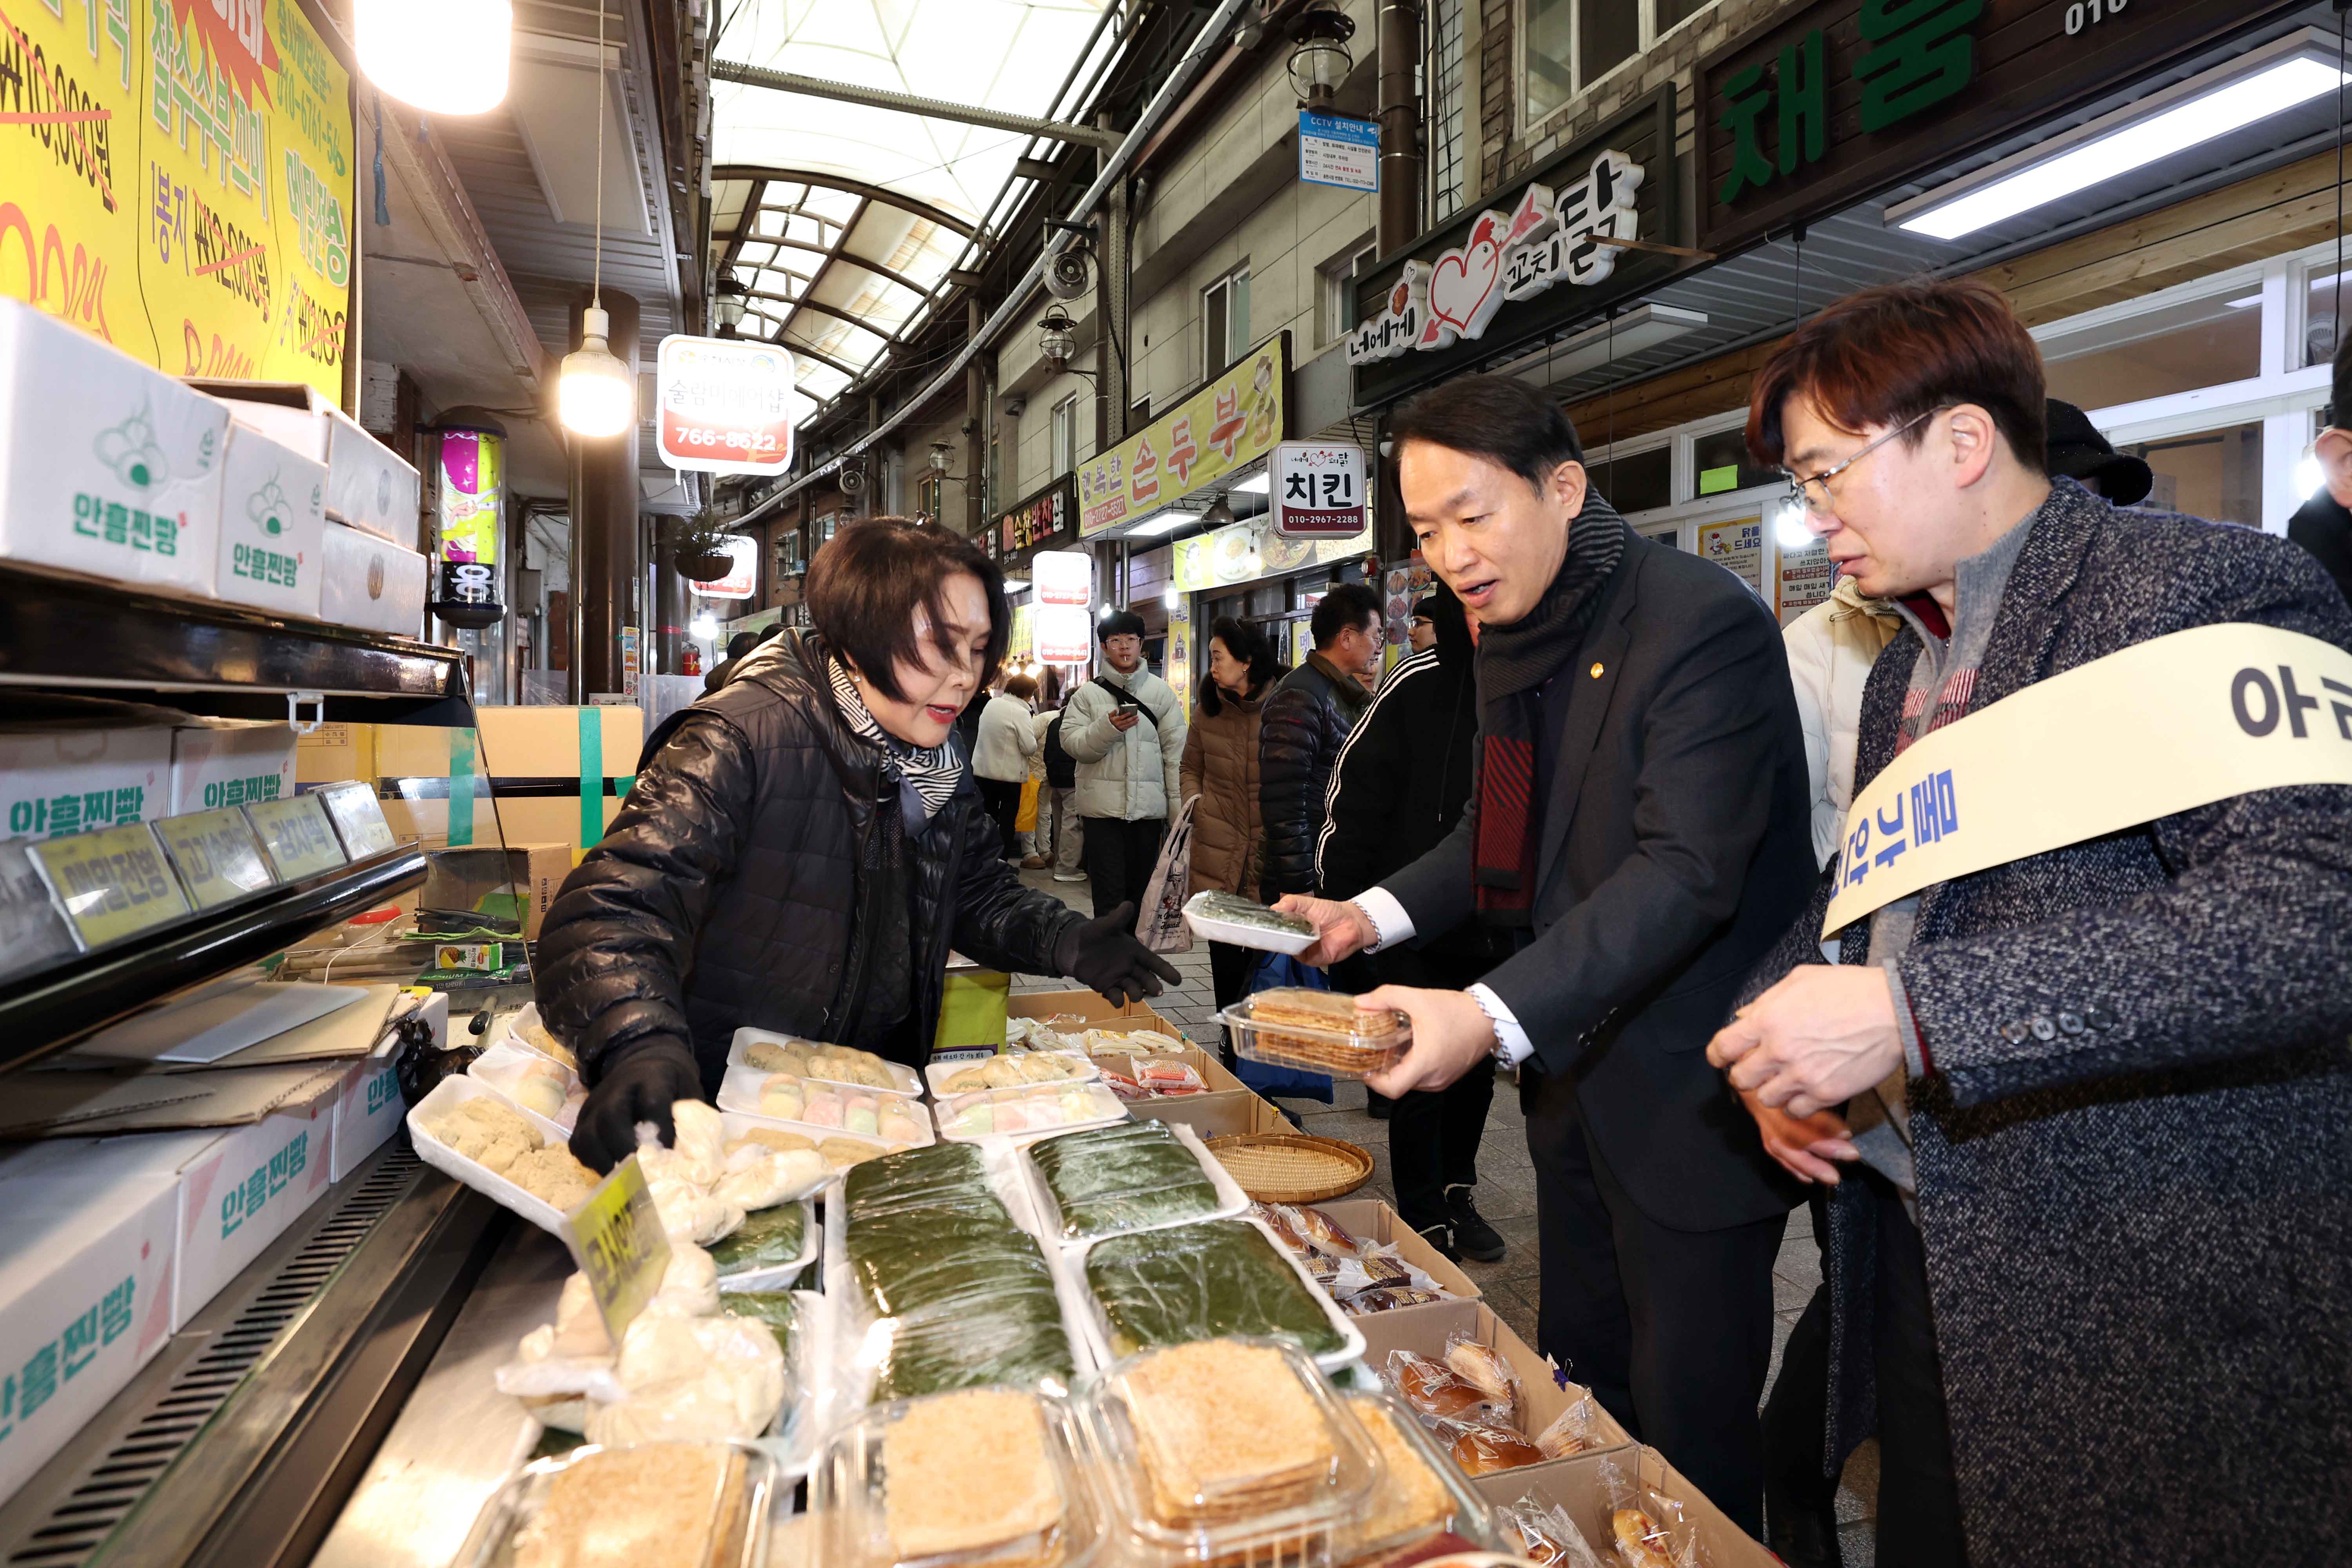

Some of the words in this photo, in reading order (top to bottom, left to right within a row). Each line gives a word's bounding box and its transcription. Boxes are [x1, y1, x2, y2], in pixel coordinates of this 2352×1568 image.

[1311, 117, 1332, 127] CCTV
[1335, 121, 1363, 133] 설치안내
[1350, 307, 1415, 357] 너에게
[1559, 158, 1622, 276] 닭
[675, 427, 776, 451] 766-8622
[1082, 454, 1122, 503] 행복한
[1132, 386, 1247, 502] 손두부
[1084, 497, 1124, 527] 010-2727-5527
[1286, 472, 1352, 508] 치킨
[73, 492, 178, 557] 안흥찐빵
[1735, 538, 1761, 550] 드세요
[233, 543, 299, 589] 안흥찐빵
[367, 1065, 400, 1117] 안흥
[222, 1131, 307, 1241] 안흥찐빵
